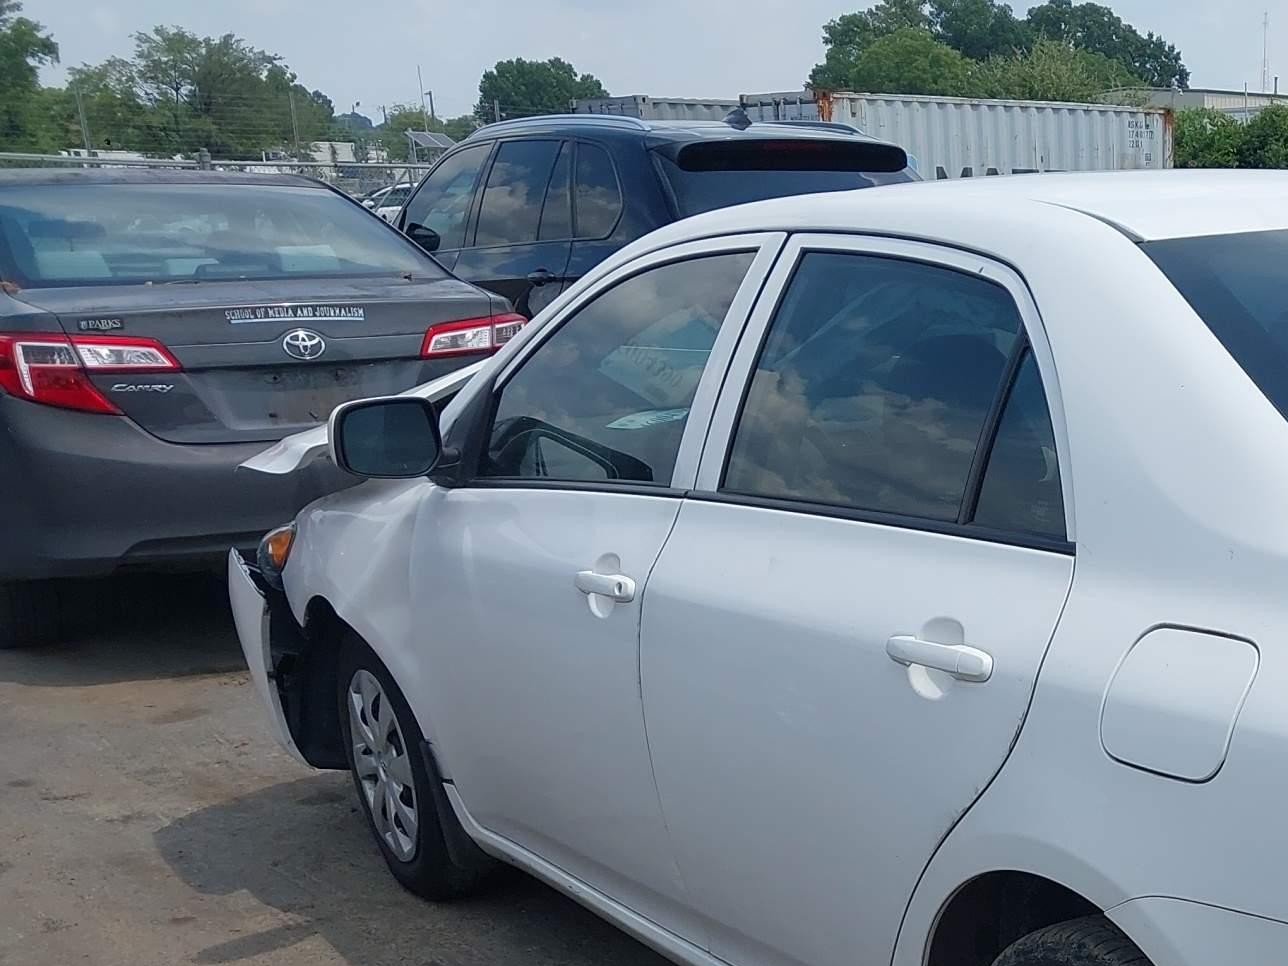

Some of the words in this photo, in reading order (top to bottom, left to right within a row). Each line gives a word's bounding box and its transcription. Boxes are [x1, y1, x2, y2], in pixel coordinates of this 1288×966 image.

[224, 308, 255, 320] SCHOOL
[256, 308, 266, 319] OF
[267, 306, 295, 318] MEDIA
[296, 306, 314, 317] AND
[315, 305, 365, 317] JOURNALISM
[88, 319, 121, 330] PARKS
[111, 383, 174, 393] CAMRY
